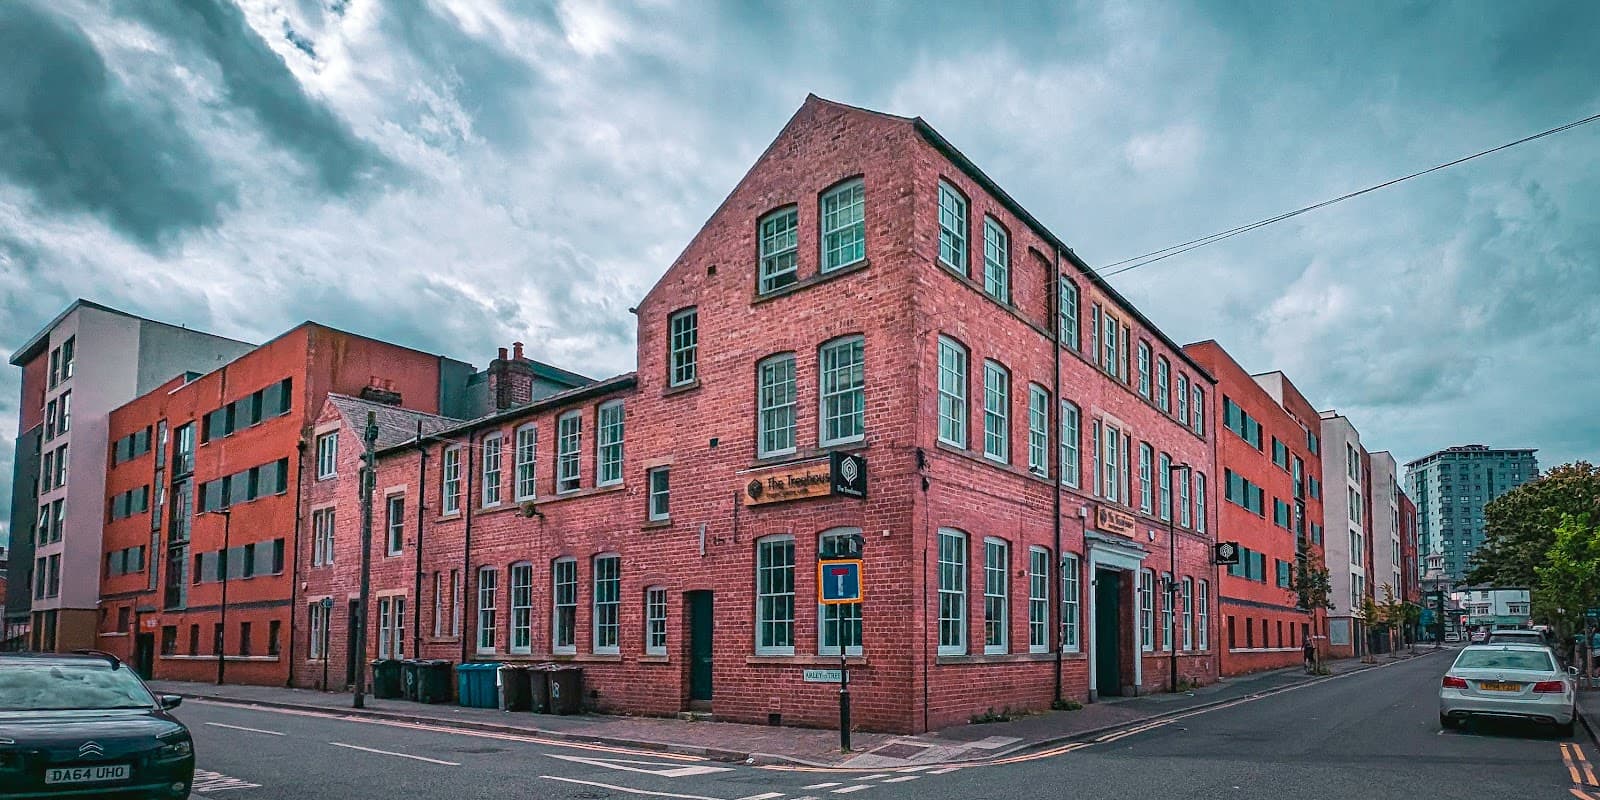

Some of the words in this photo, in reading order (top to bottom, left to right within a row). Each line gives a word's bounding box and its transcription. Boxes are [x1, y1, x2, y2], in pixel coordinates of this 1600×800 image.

[767, 476, 784, 490] The
[787, 470, 831, 488] Treehous
[53, 768, 91, 781] DA64
[96, 767, 124, 779] UHO
